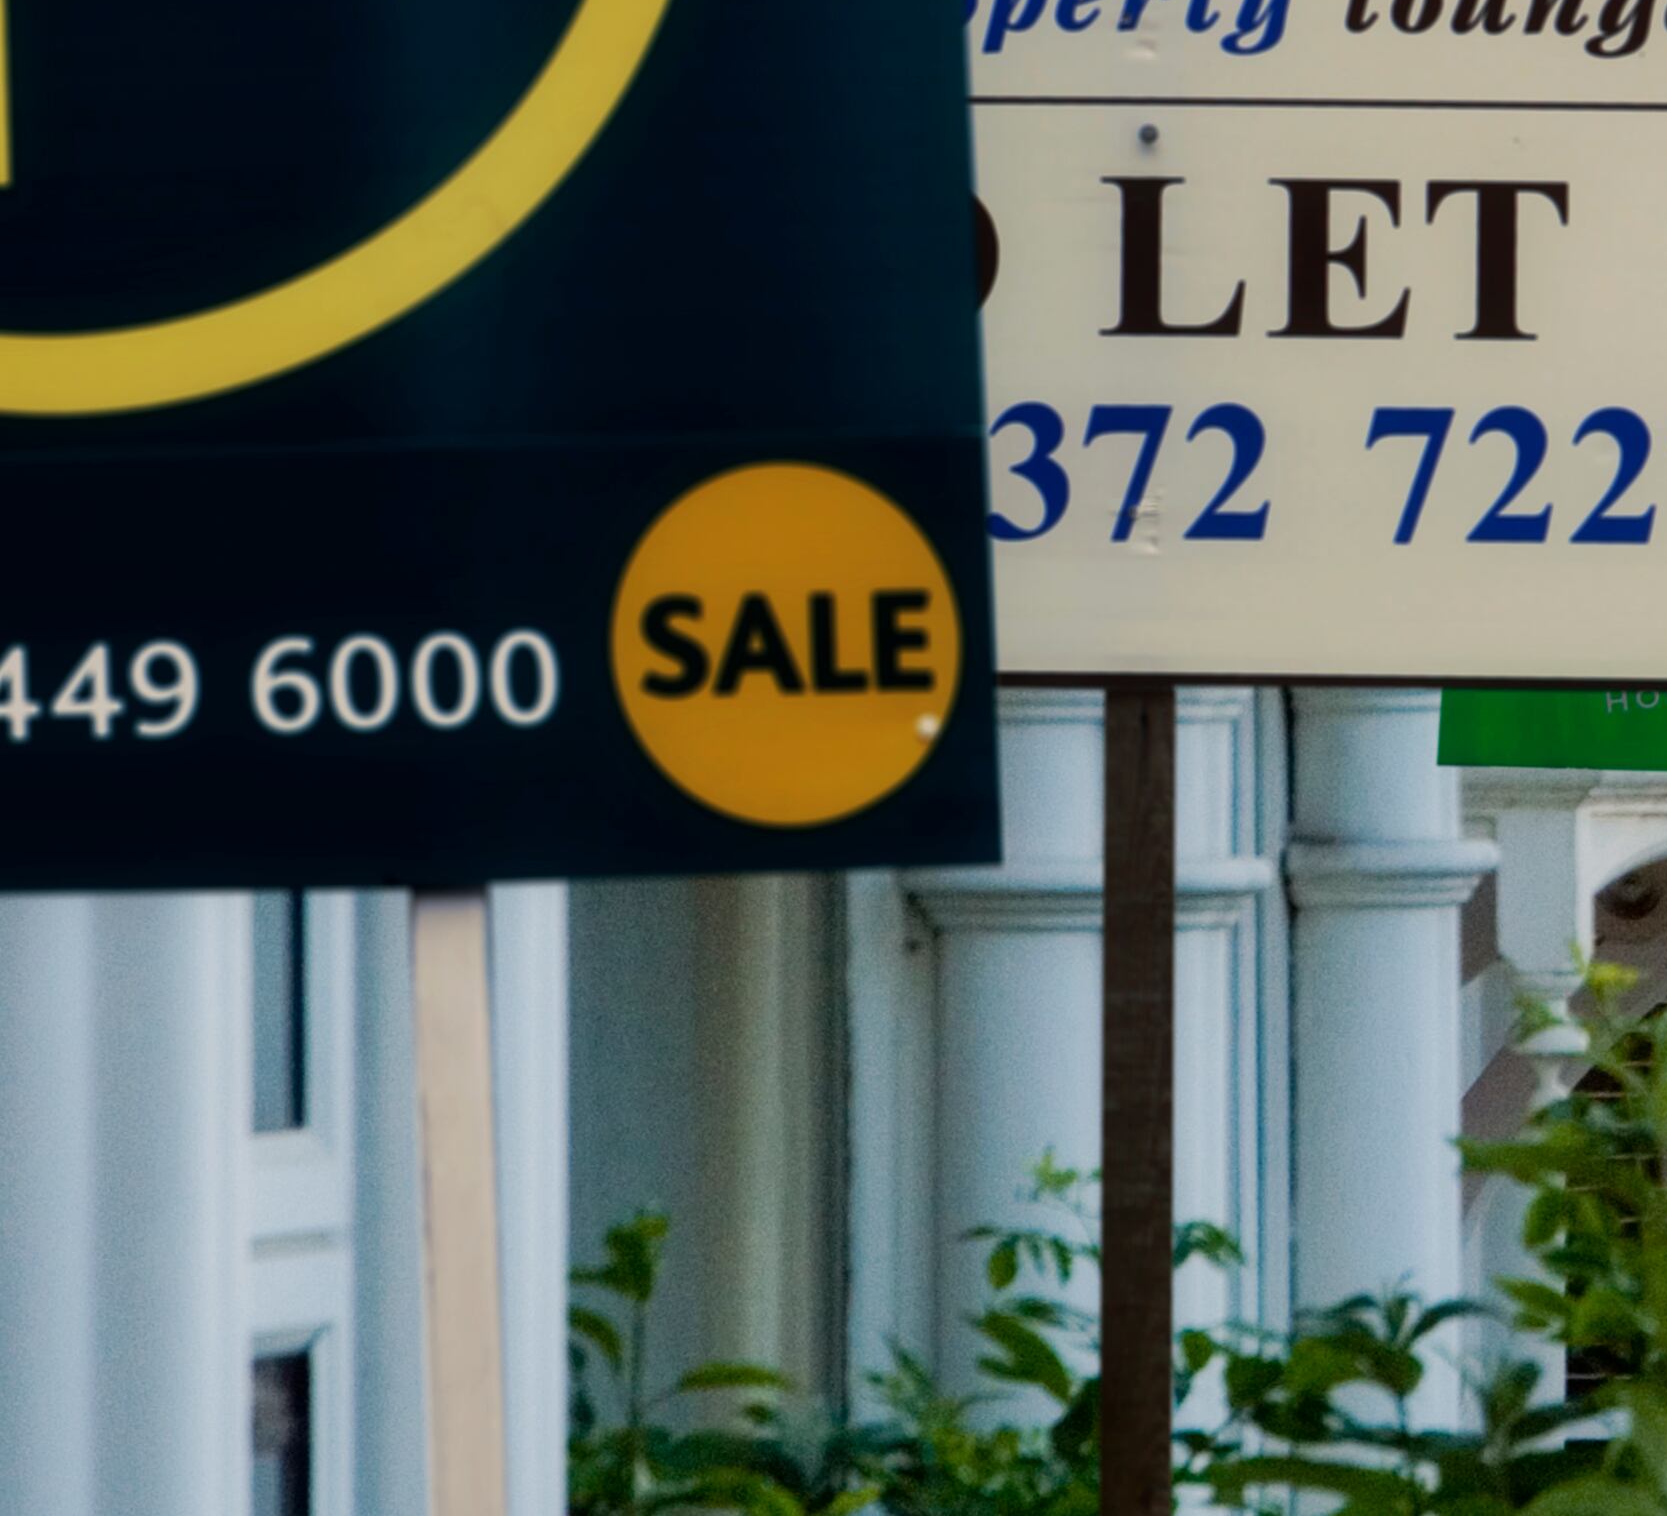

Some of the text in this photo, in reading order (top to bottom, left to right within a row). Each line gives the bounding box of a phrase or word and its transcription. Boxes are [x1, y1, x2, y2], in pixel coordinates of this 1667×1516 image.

[1099, 175, 1571, 341] LET
[986, 401, 1271, 542] 372
[0, 630, 558, 741] 449 6000
[640, 588, 936, 699] SALE
